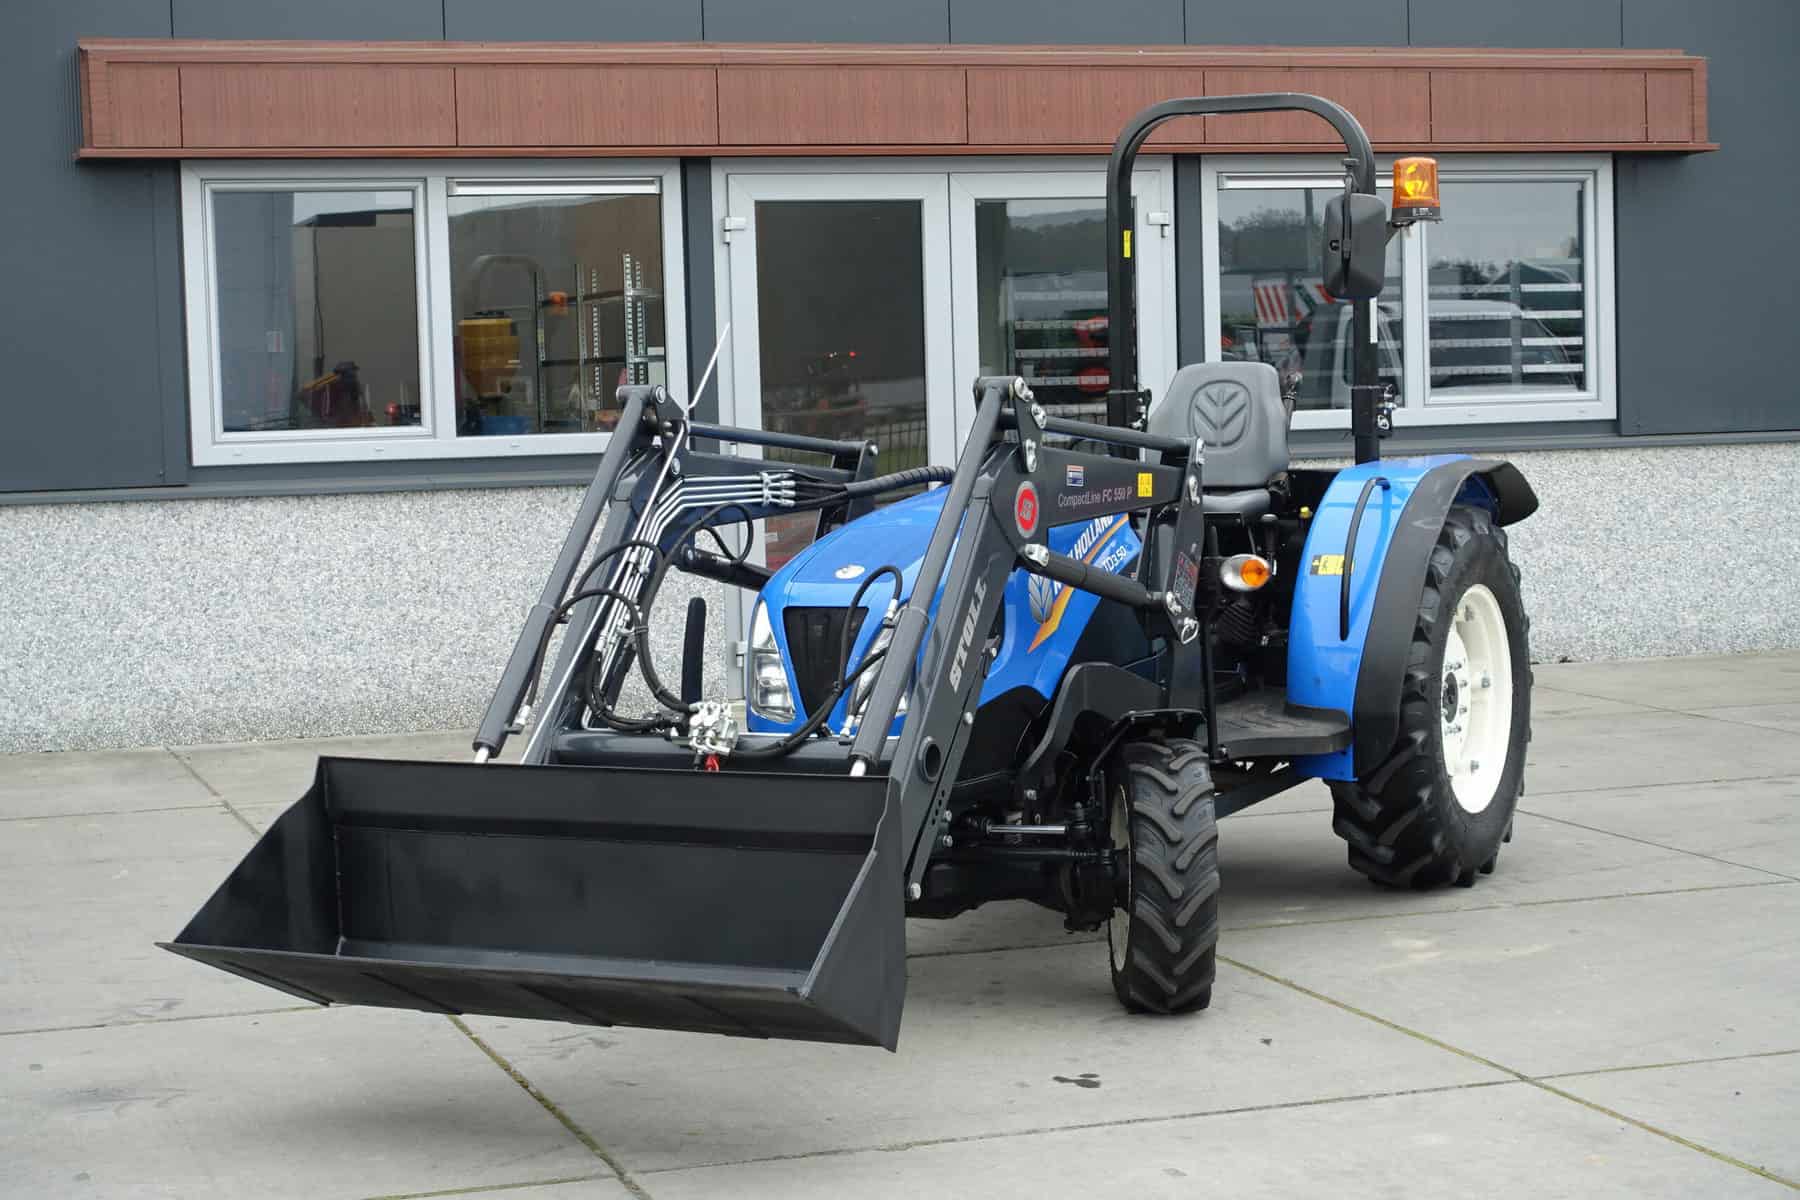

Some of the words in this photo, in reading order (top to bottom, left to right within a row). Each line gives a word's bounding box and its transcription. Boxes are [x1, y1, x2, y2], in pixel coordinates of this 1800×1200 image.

[1057, 490, 1101, 509] CompactLine
[1102, 488, 1113, 503] FC
[1113, 487, 1126, 501] 550
[1126, 486, 1133, 500] P
[949, 576, 987, 694] STOLL
